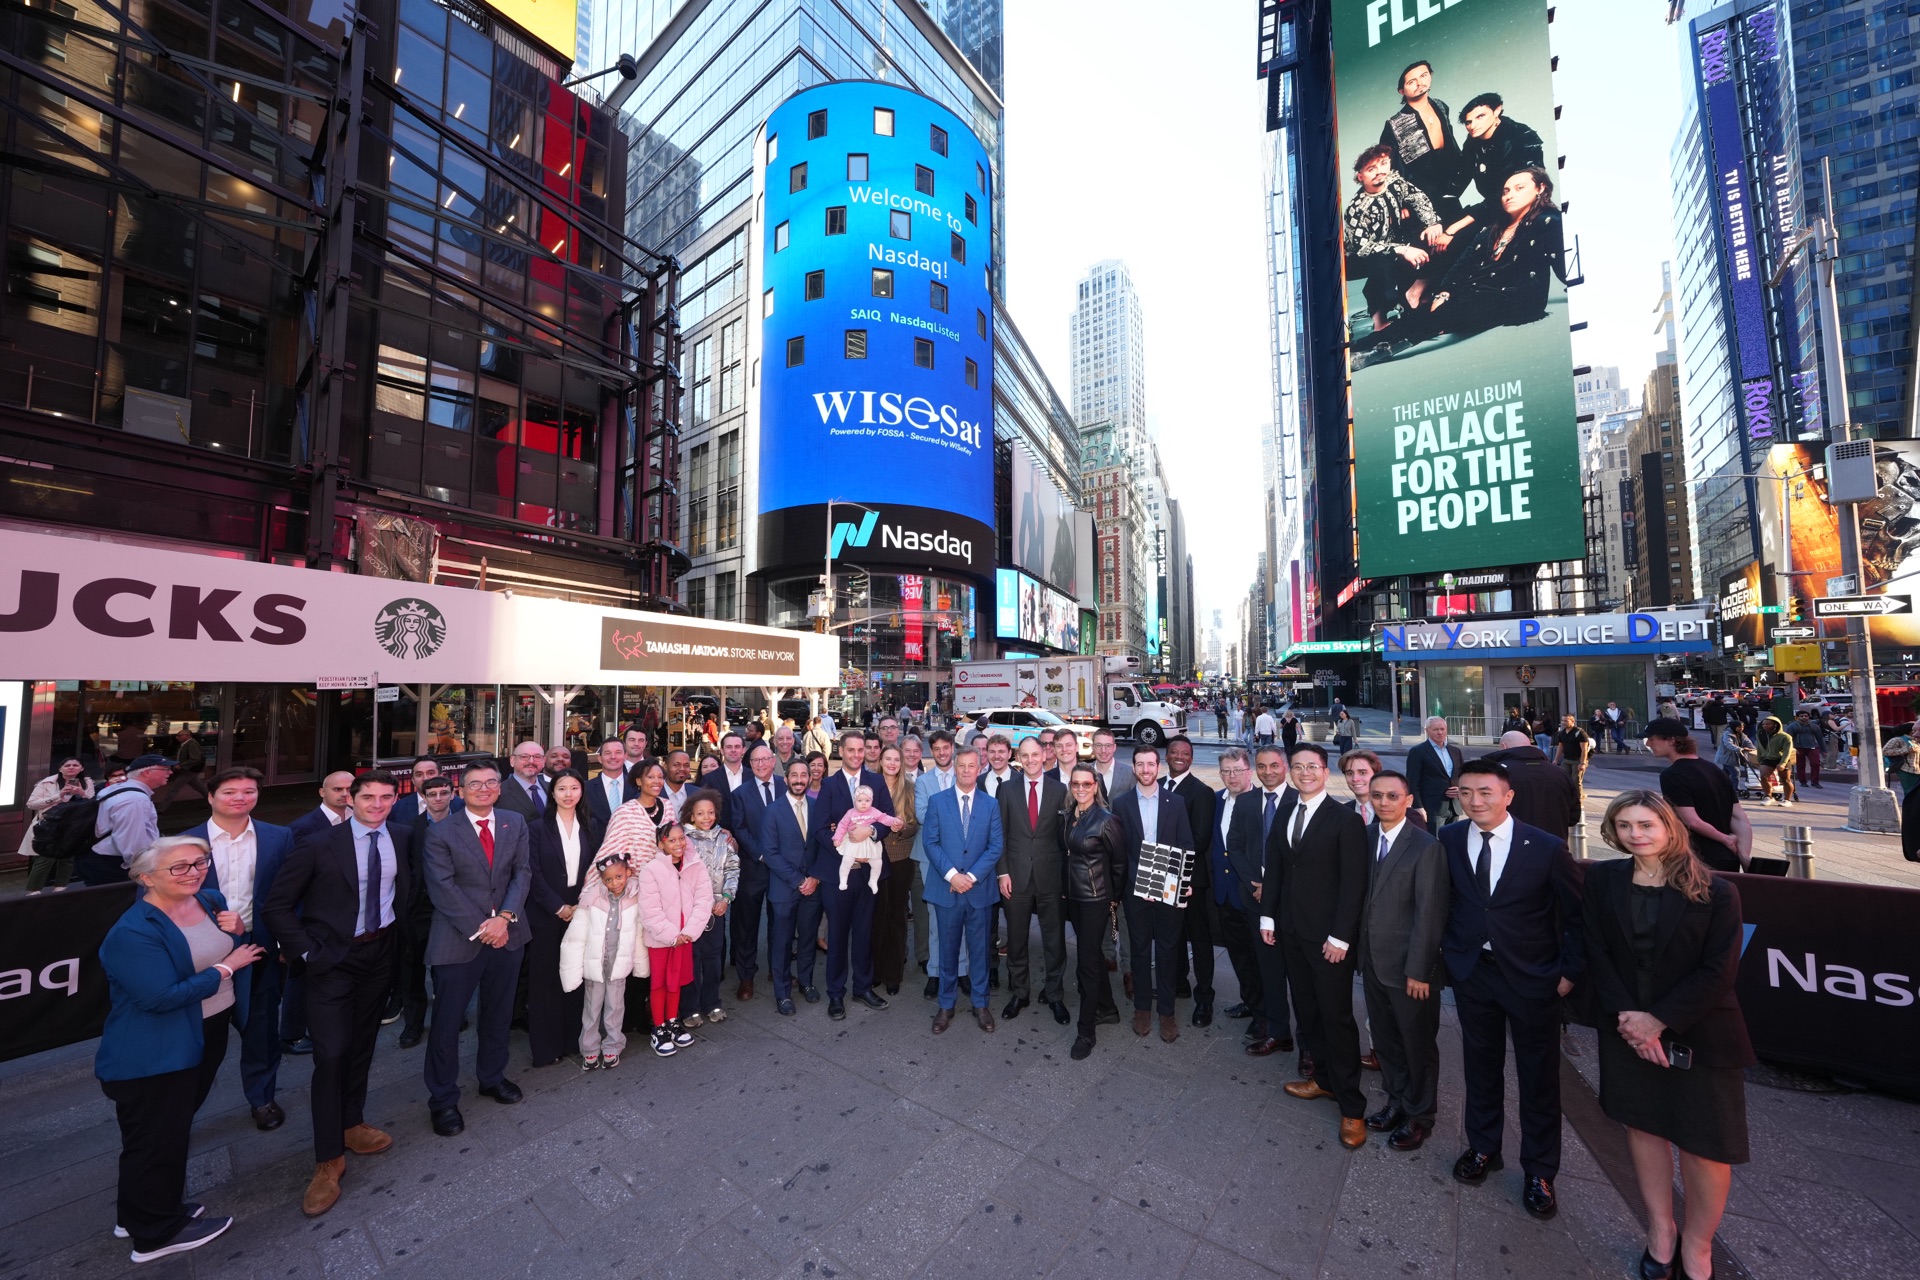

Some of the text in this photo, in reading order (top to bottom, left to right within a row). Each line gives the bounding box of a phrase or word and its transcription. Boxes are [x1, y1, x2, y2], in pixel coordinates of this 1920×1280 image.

[849, 186, 962, 232] Welcome to
[1725, 169, 1751, 280] TV IS BETTER HERE
[868, 242, 948, 280] Nasdaq!
[850, 308, 882, 322] SAIQ
[1392, 380, 1522, 422] THE NEW ALBUM
[830, 428, 866, 436] Powered
[866, 428, 876, 436] by
[878, 428, 904, 438] FOSSA
[910, 432, 940, 444] Secured
[940, 438, 948, 448] by
[1394, 401, 1526, 460] PALACE
[1392, 440, 1534, 498] FOR THE
[1398, 482, 1532, 535] PEOPLE
[882, 524, 972, 565] Nasdaq
[1824, 601, 1891, 611] ONE WAY
[646, 641, 690, 655] TAMASHII
[730, 648, 756, 660] STORE
[758, 650, 774, 660] NEW
[775, 650, 794, 662] YORK
[1383, 626, 1438, 651] NEW
[1442, 624, 1510, 650] YORK
[1520, 620, 1614, 647] POLICE
[1627, 614, 1714, 644] DEPT
[1767, 948, 1920, 1006] Nas
